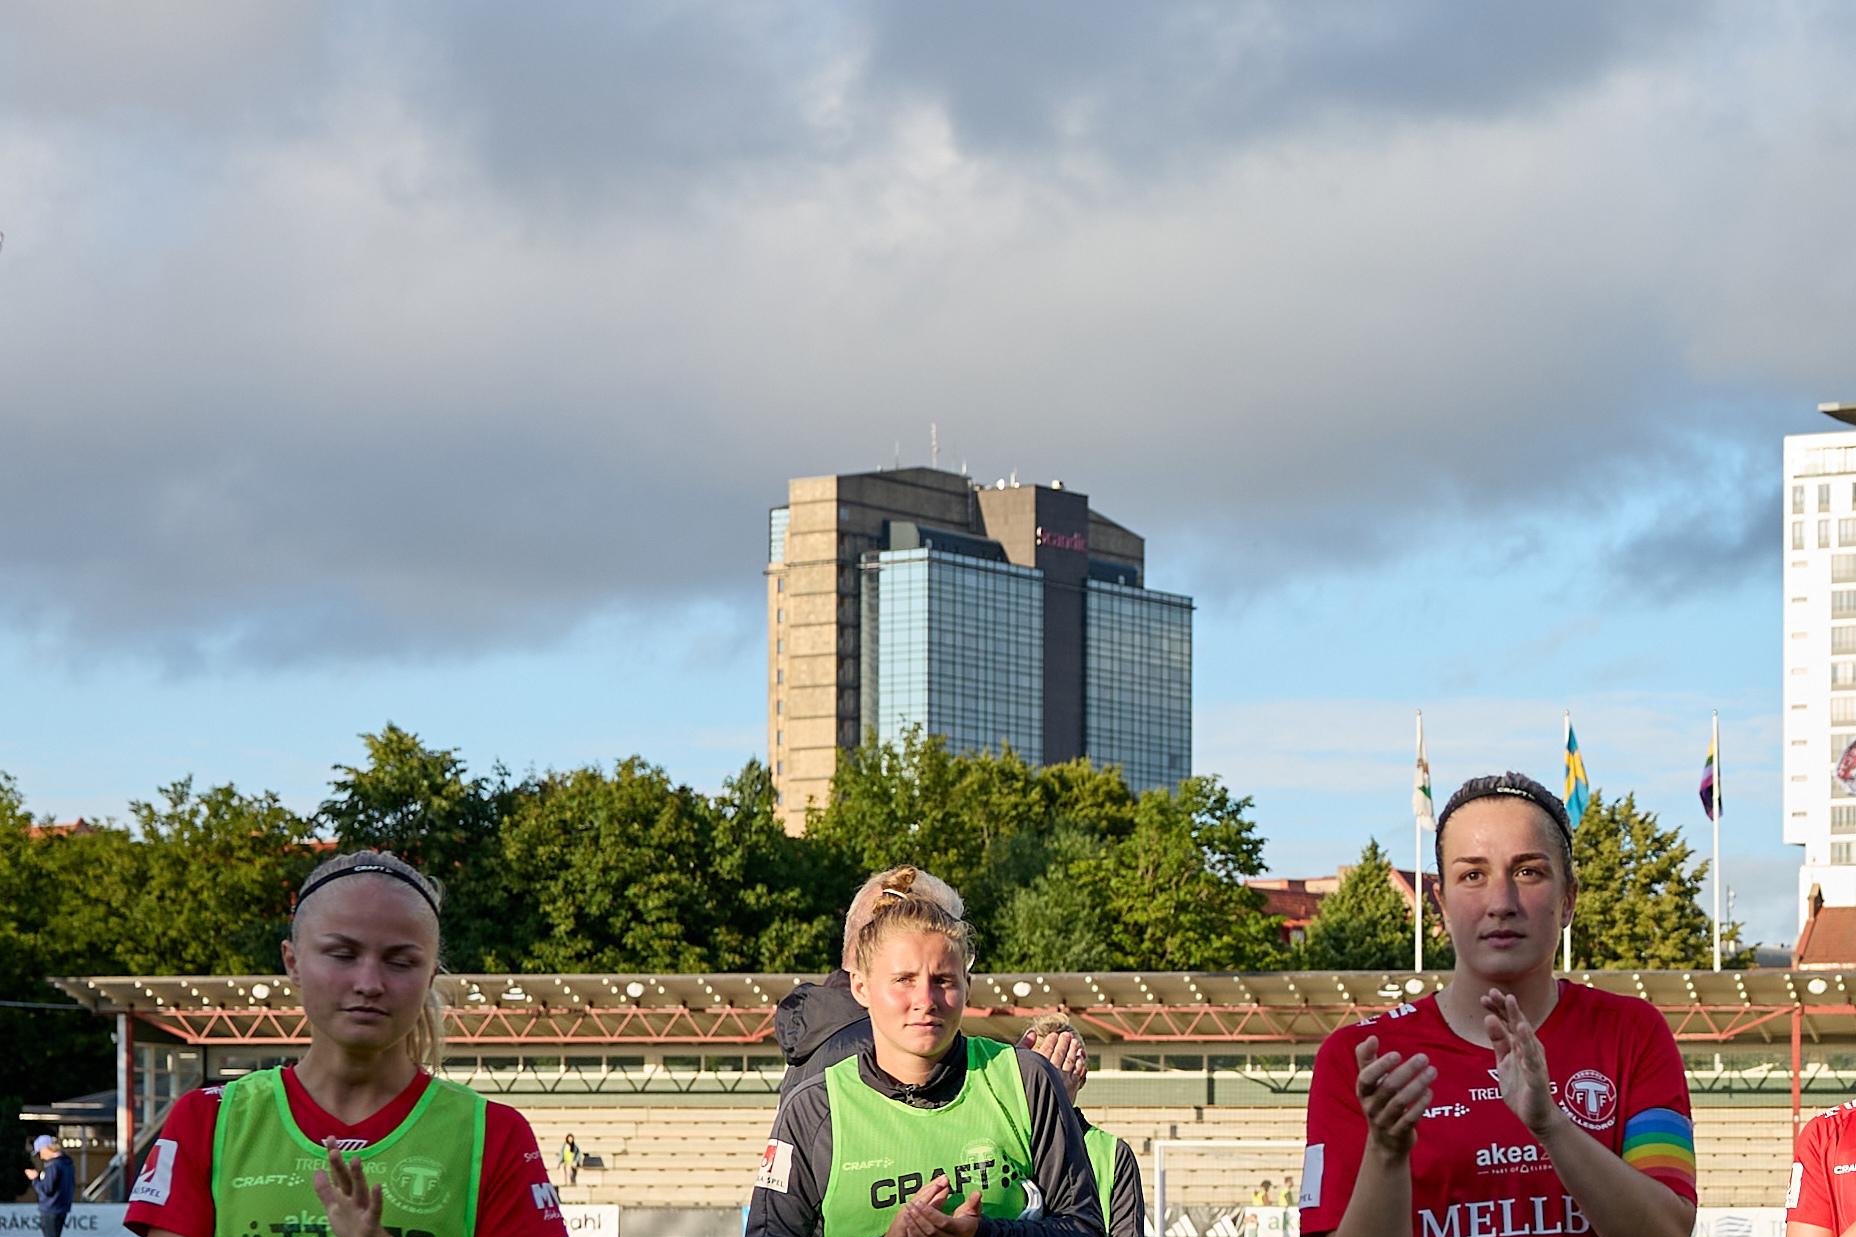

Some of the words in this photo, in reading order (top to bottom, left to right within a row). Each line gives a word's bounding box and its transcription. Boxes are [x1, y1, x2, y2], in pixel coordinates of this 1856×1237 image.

[1497, 787, 1527, 796] CRAFT
[1476, 1142, 1538, 1167] akea
[842, 1160, 882, 1172] CRAFT
[233, 1174, 288, 1188] CRAFT
